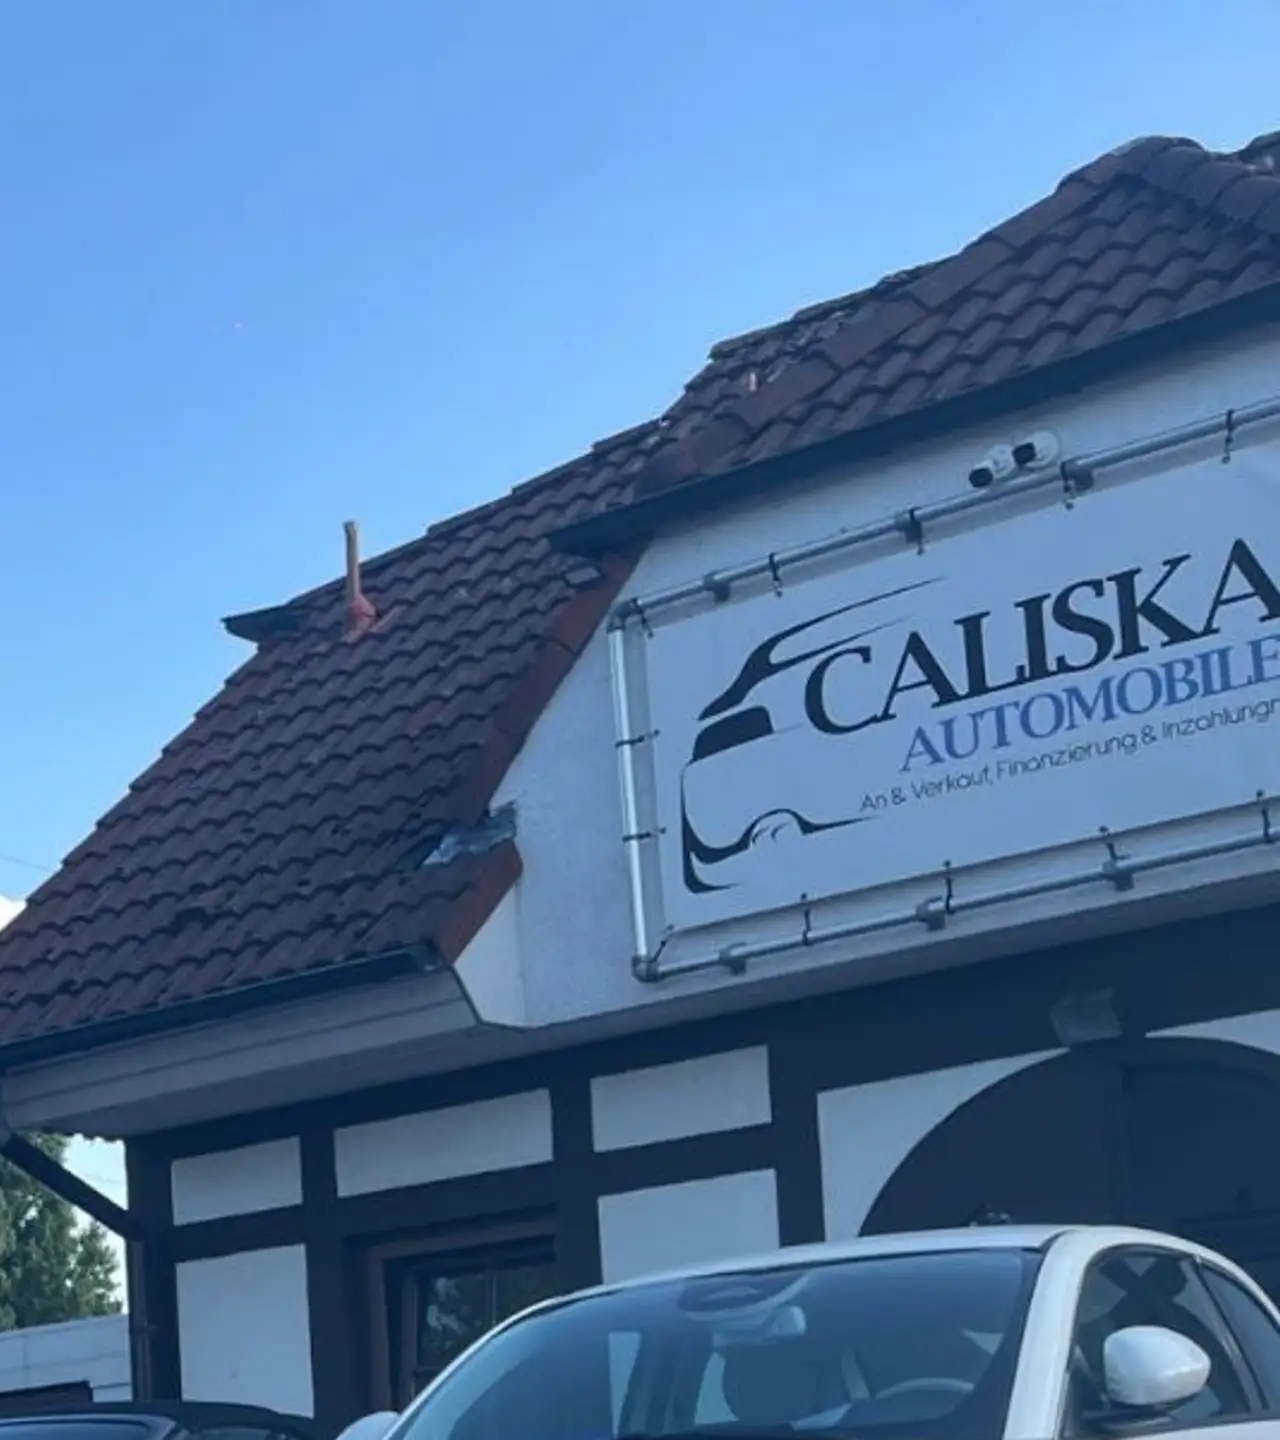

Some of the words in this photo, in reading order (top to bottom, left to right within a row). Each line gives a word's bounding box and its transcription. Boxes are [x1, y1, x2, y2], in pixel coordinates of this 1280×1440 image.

[803, 537, 1280, 735] CALISKA
[898, 633, 1280, 773] AUTOMOBILE
[860, 794, 888, 812] An
[891, 786, 907, 806] &
[996, 734, 1138, 782] Finanzierung
[1141, 724, 1158, 745] &
